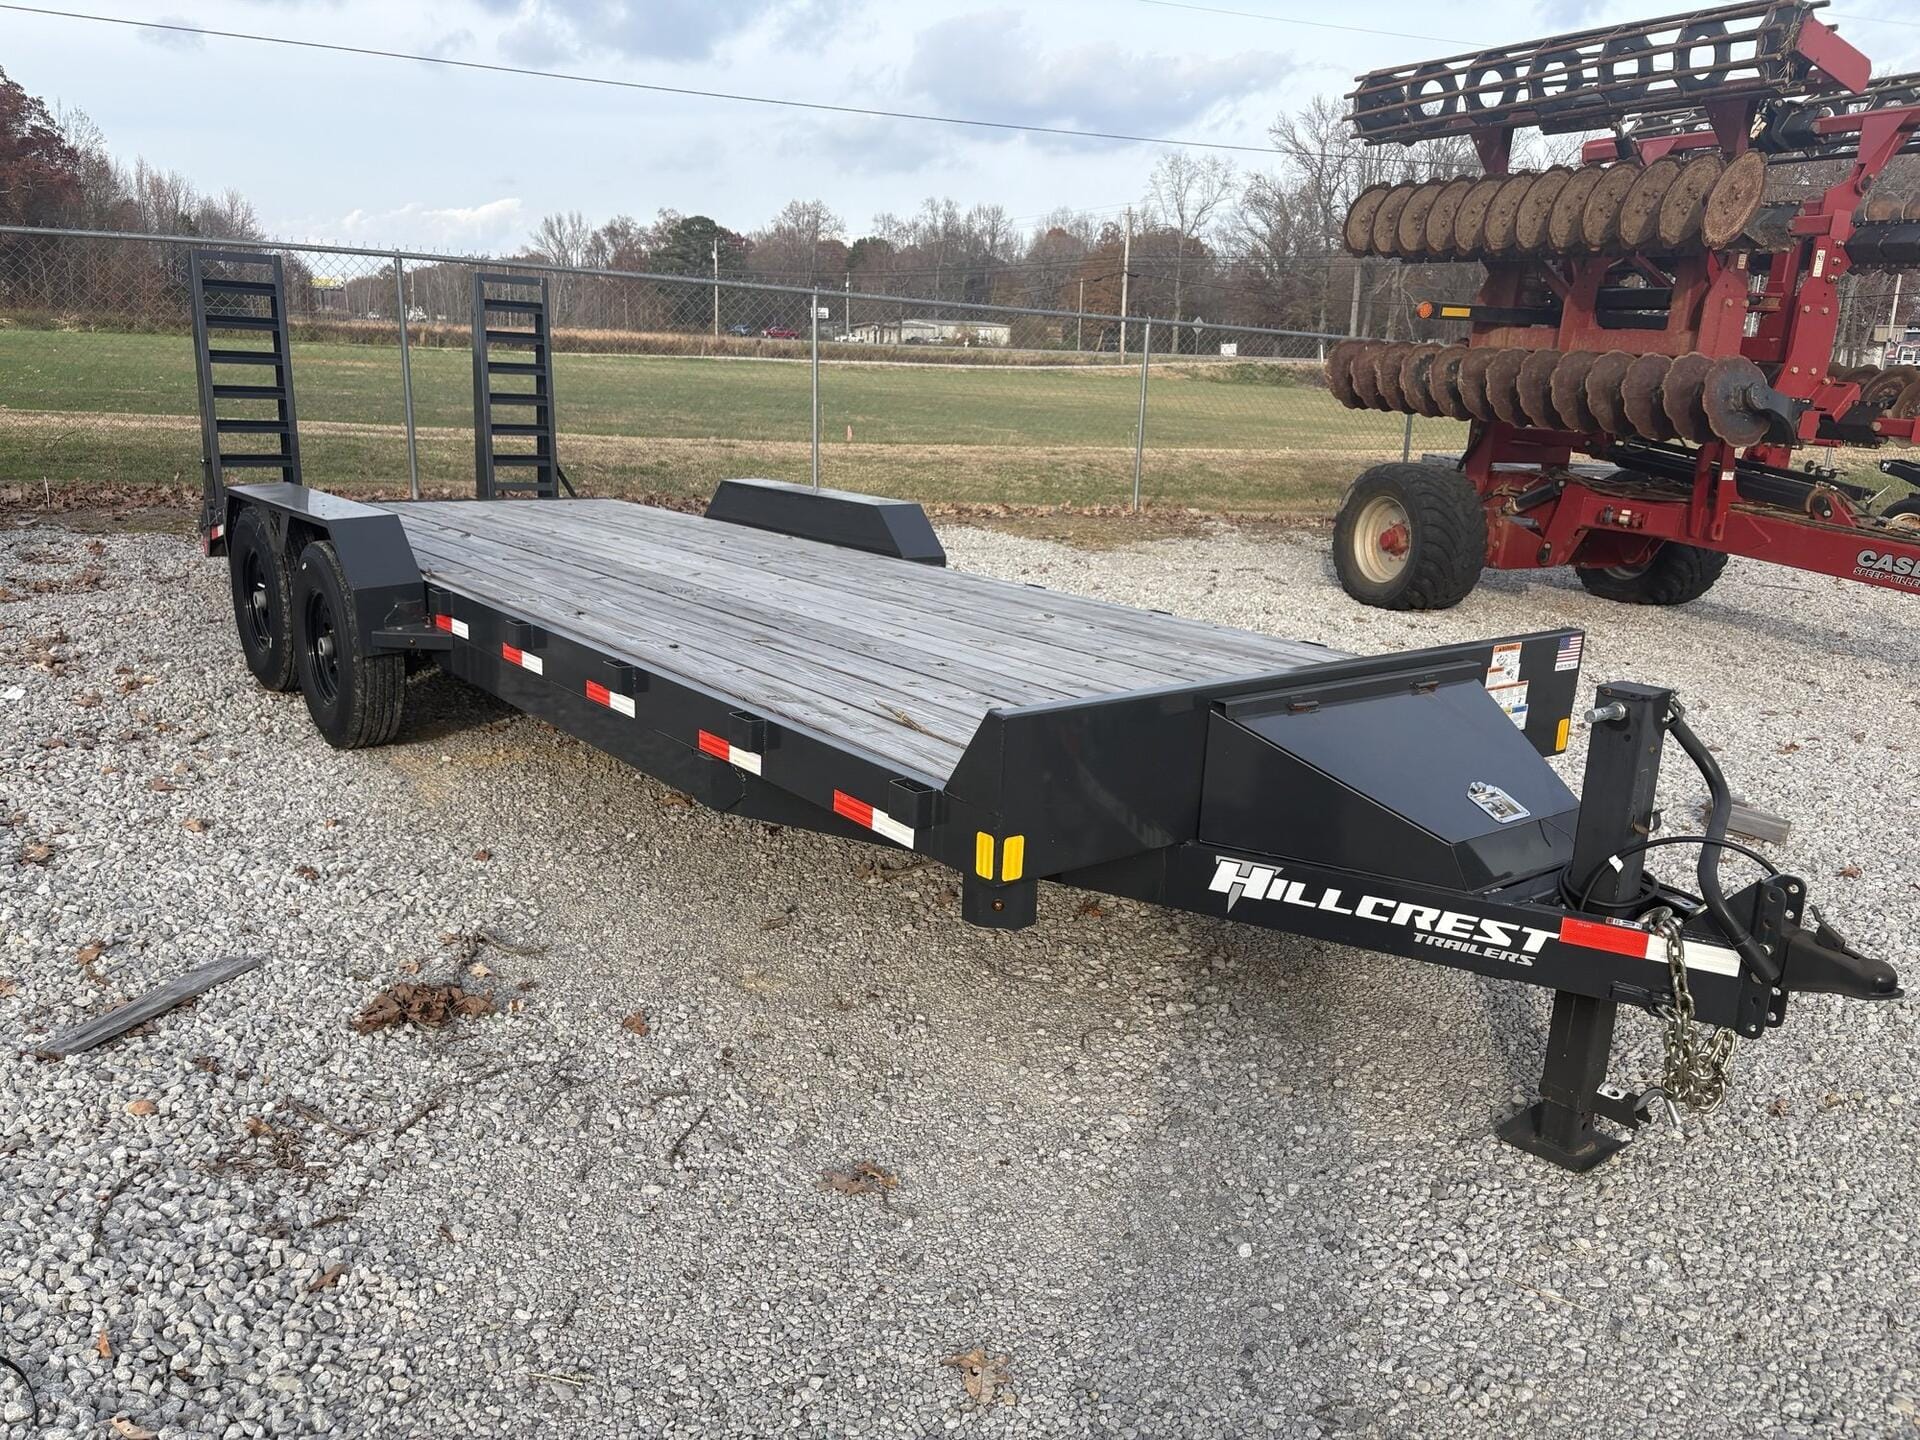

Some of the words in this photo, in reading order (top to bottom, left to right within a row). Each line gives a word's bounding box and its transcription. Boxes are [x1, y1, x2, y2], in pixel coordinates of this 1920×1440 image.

[1853, 567, 1920, 588] SPEED-TILLE
[1208, 855, 1561, 954] HILLCREST
[1414, 932, 1537, 967] TRAILERS
